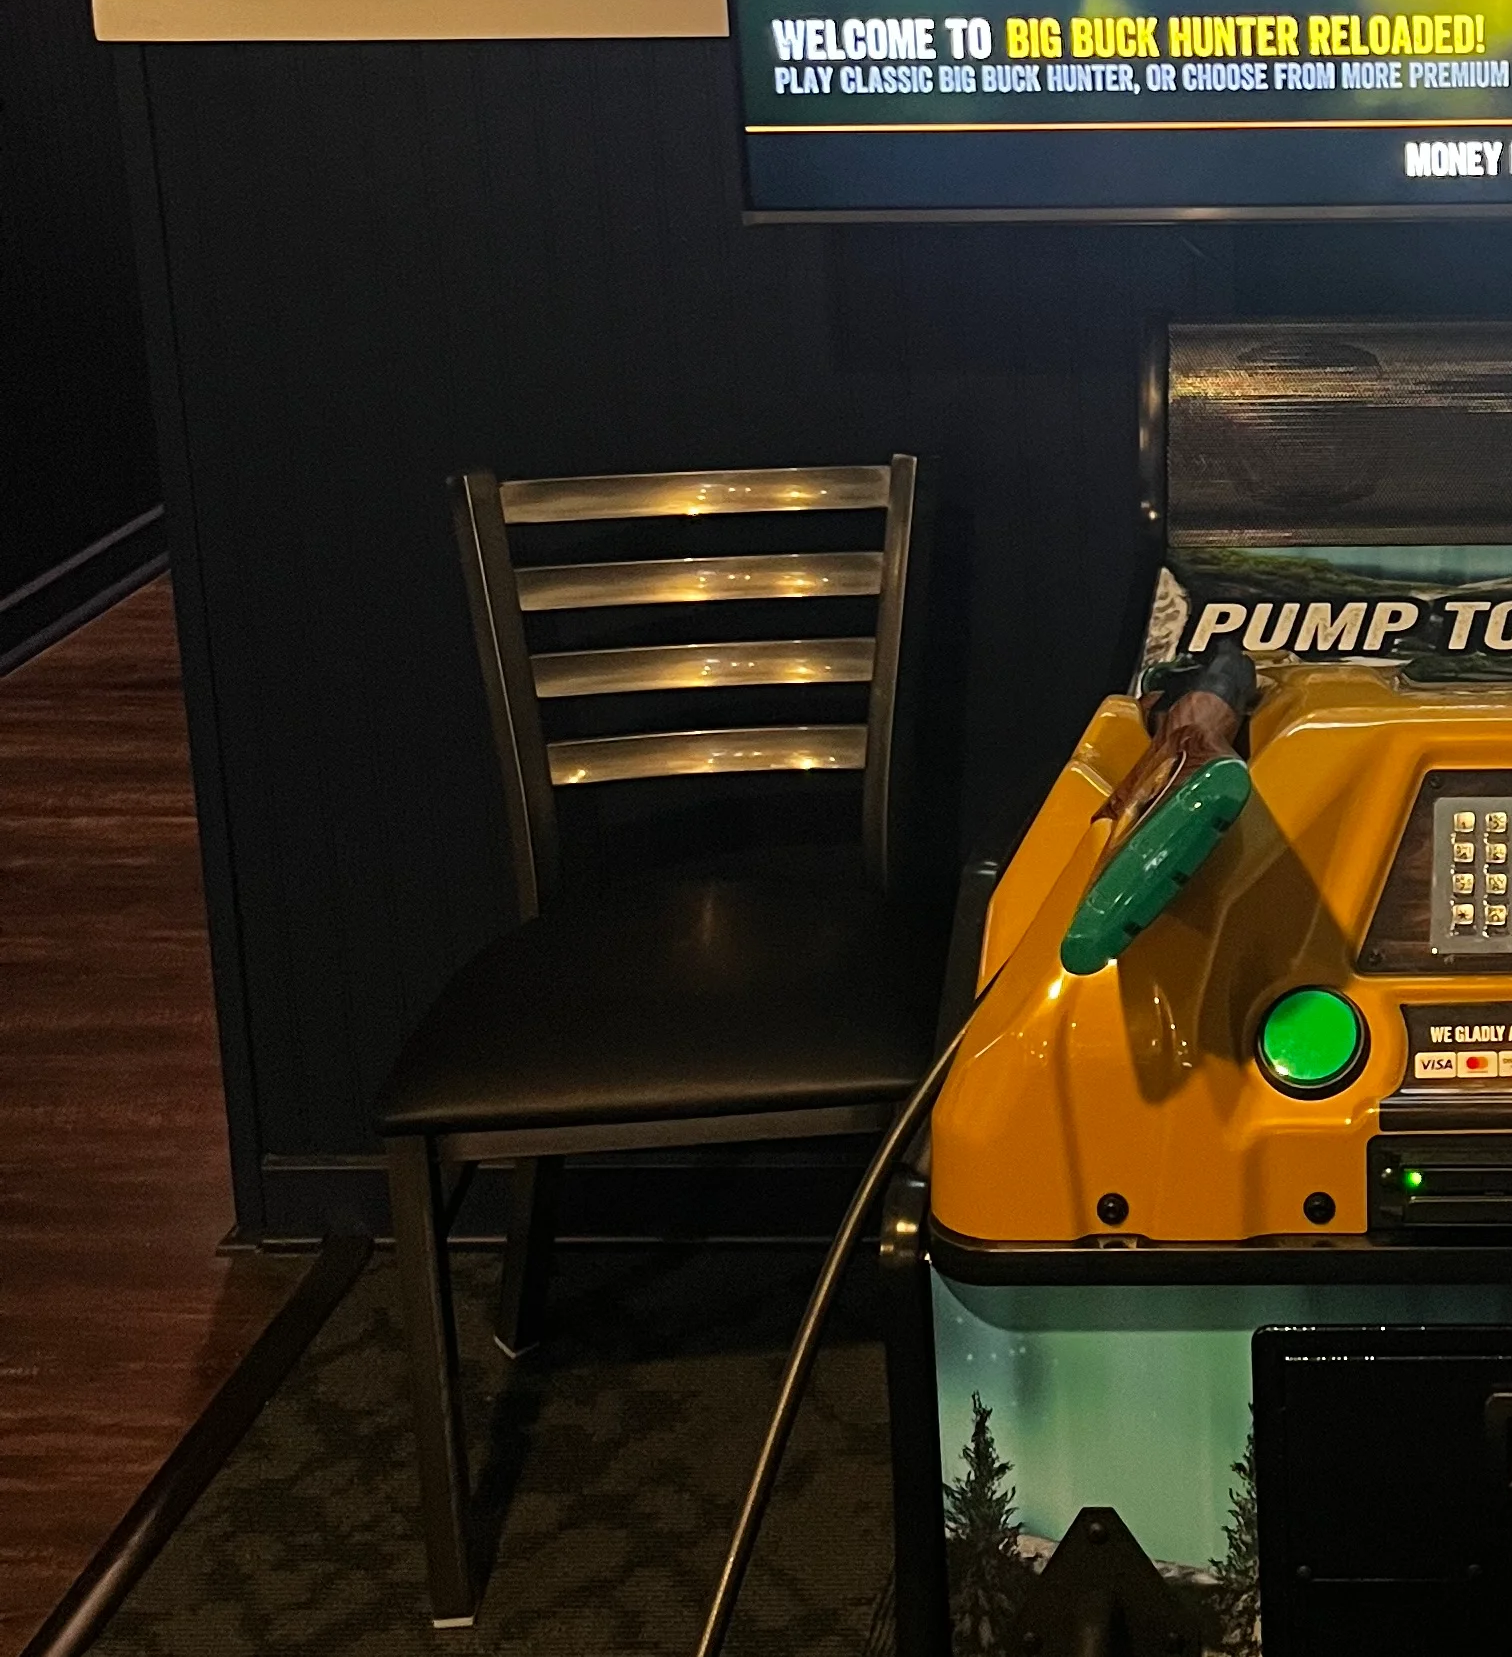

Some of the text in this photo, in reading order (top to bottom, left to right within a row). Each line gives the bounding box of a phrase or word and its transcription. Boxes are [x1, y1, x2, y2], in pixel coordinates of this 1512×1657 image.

[772, 14, 1486, 61] WELCOME TO BIG BUCK HUNTER RELOADED!
[774, 66, 833, 95] PLAY
[840, 65, 934, 94] CLASSIC
[939, 65, 976, 93] BIG
[981, 64, 1042, 93] BUCK
[1047, 63, 1141, 96] HUNTER,
[1146, 63, 1177, 92] OR
[1182, 62, 1269, 92] CHOOSE
[1274, 62, 1336, 91] FROM
[1342, 61, 1401, 90] MORE
[1409, 60, 1510, 89] PREMIUM
[1405, 141, 1503, 177] MONEY
[1189, 602, 1422, 653] PUMP
[1430, 1026, 1452, 1043] WE
[1455, 1025, 1506, 1043] GLADLY
[1421, 1059, 1453, 1070] VISA
